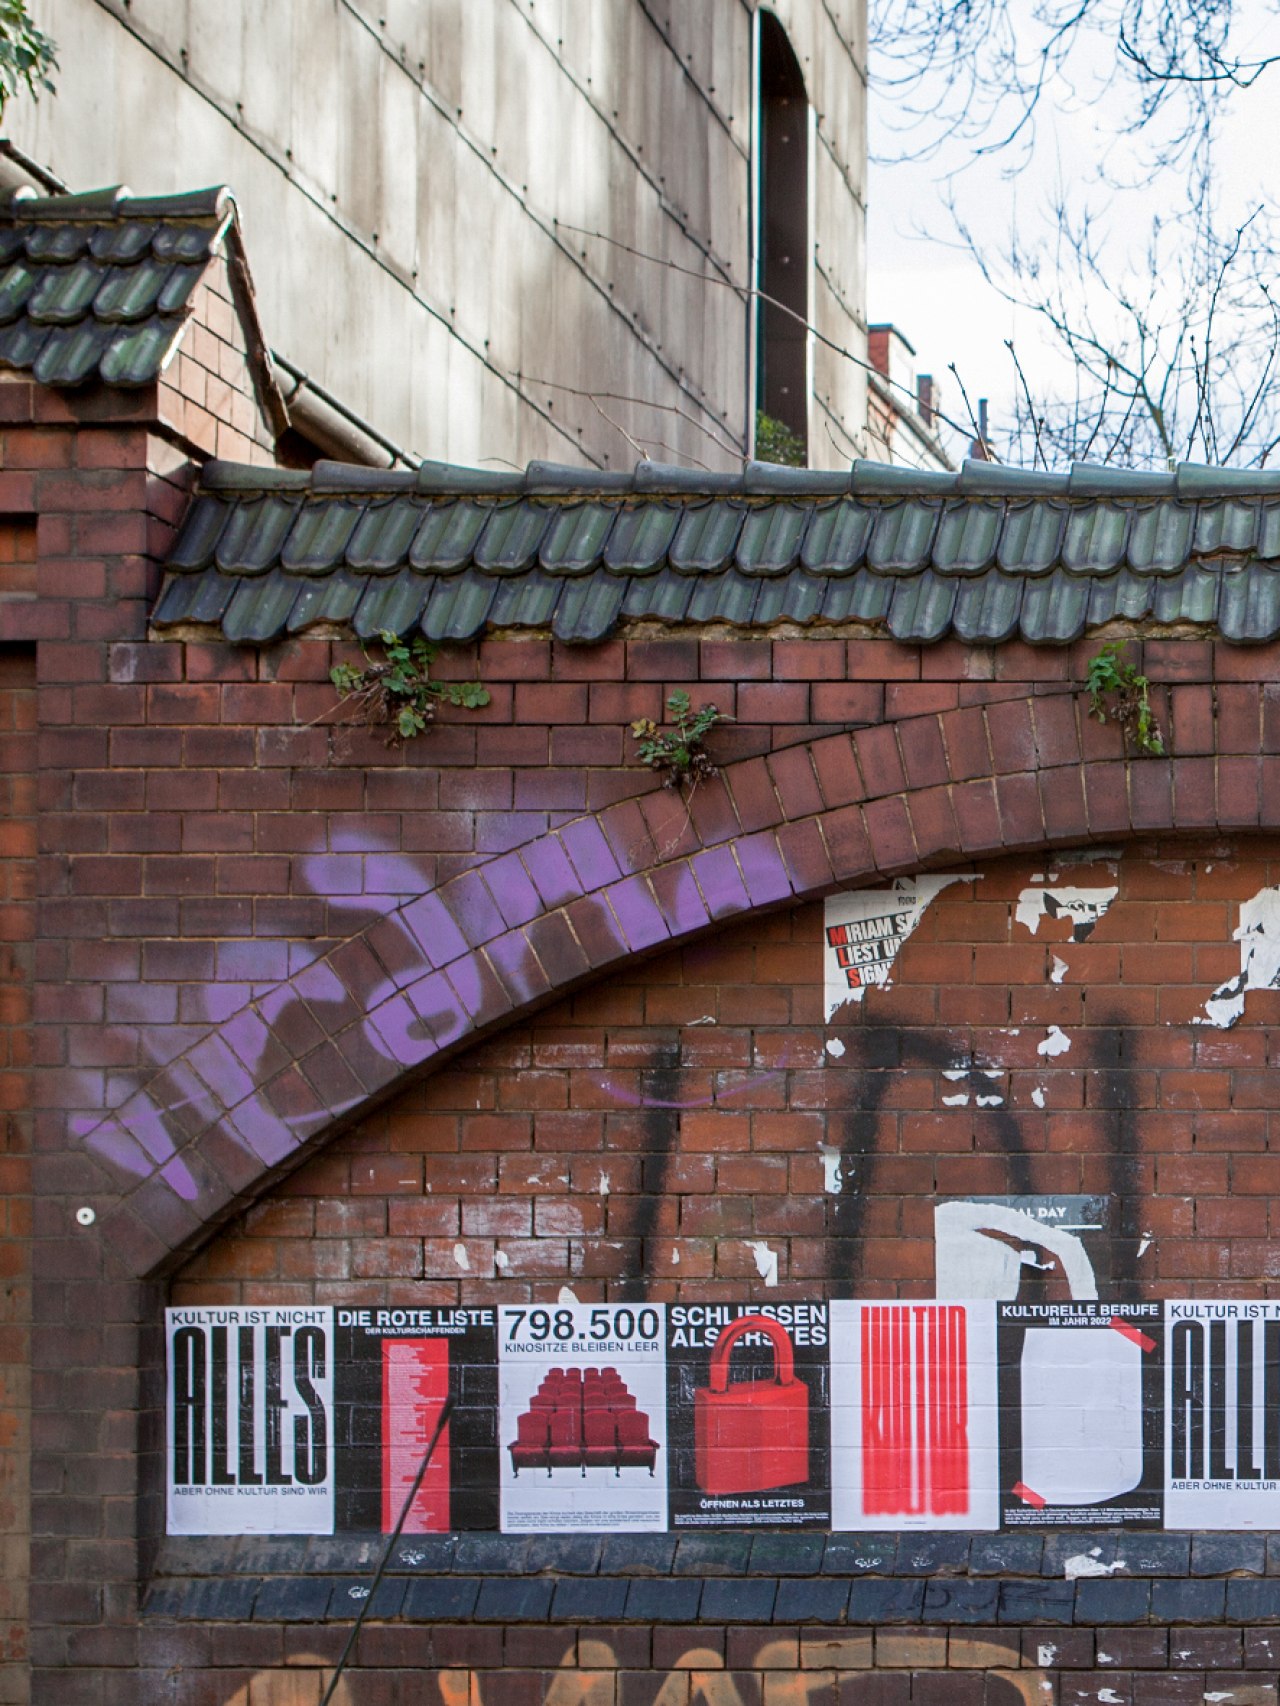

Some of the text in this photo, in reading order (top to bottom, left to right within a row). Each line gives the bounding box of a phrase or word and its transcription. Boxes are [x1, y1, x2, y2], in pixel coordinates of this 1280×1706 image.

[829, 912, 913, 947] MIRIAM S
[837, 942, 880, 967] LIEST
[1038, 1207, 1067, 1217] DAY
[1002, 1304, 1159, 1317] KULTURELLE BERUFE
[1171, 1305, 1238, 1318] KULTUR
[1244, 1305, 1270, 1317] IST
[172, 1311, 326, 1325] KULTUR IST NICHT
[338, 1310, 493, 1327] DIE ROTE LISTE
[504, 1308, 659, 1340] 798.500
[1062, 1317, 1088, 1326] JAHR
[671, 1327, 719, 1347] ALS
[505, 1341, 659, 1353] KINOSITZE BLEIBEN LEER
[174, 1326, 327, 1485] ALLES
[174, 1487, 327, 1496] ABER OHNE KULTUR SIND WIR
[1171, 1482, 1199, 1490] ABER
[1203, 1482, 1232, 1490] OHNE
[1236, 1482, 1276, 1490] KULTUR
[741, 1499, 760, 1508] ALS
[762, 1499, 804, 1508] LETZTES
